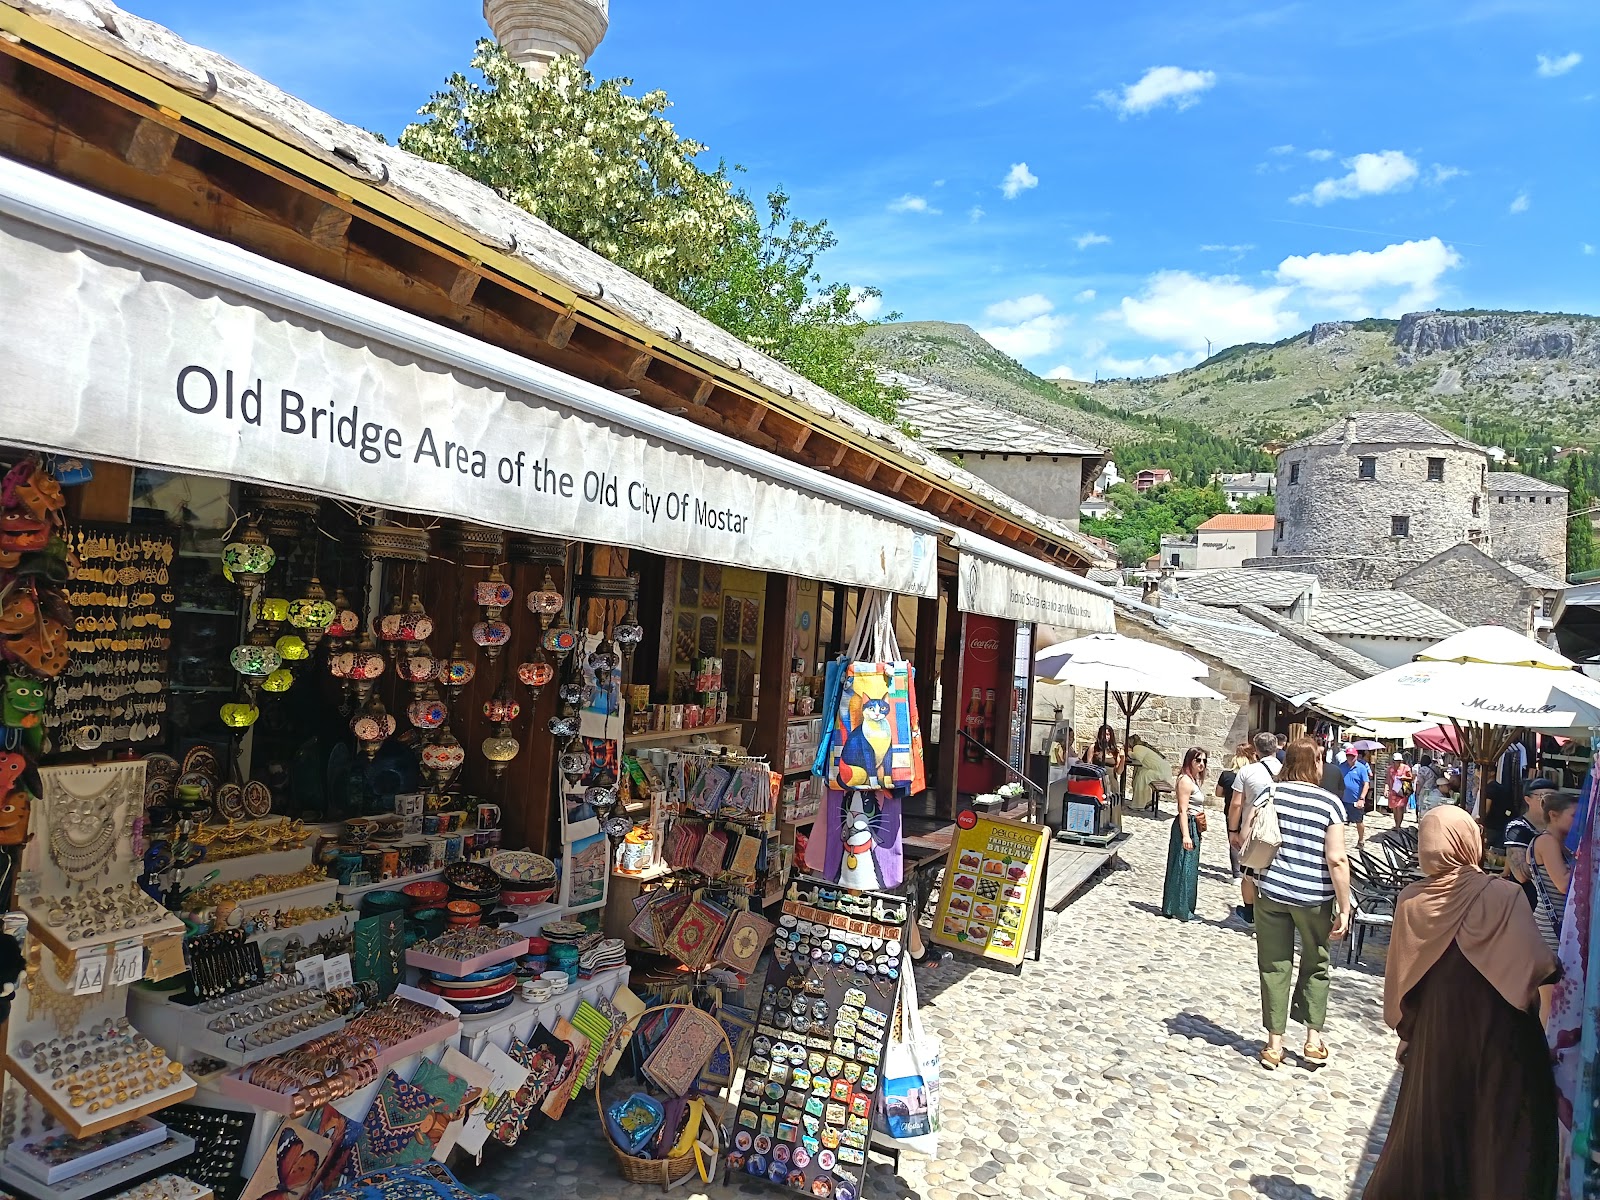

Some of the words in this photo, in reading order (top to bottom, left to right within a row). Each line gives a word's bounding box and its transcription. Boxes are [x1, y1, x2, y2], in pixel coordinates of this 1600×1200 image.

[176, 365, 262, 427] Old
[281, 388, 403, 464] Bridge
[413, 427, 488, 479] Area
[498, 451, 527, 487] of
[532, 457, 575, 499] the
[583, 470, 619, 508] Old
[628, 481, 662, 525] City
[667, 492, 691, 522] Of
[695, 497, 749, 535] Mostar
[1461, 697, 1557, 714] Marshall
[987, 844, 1033, 860] BAKLAVA
[989, 837, 1034, 852] TRADITIONAL
